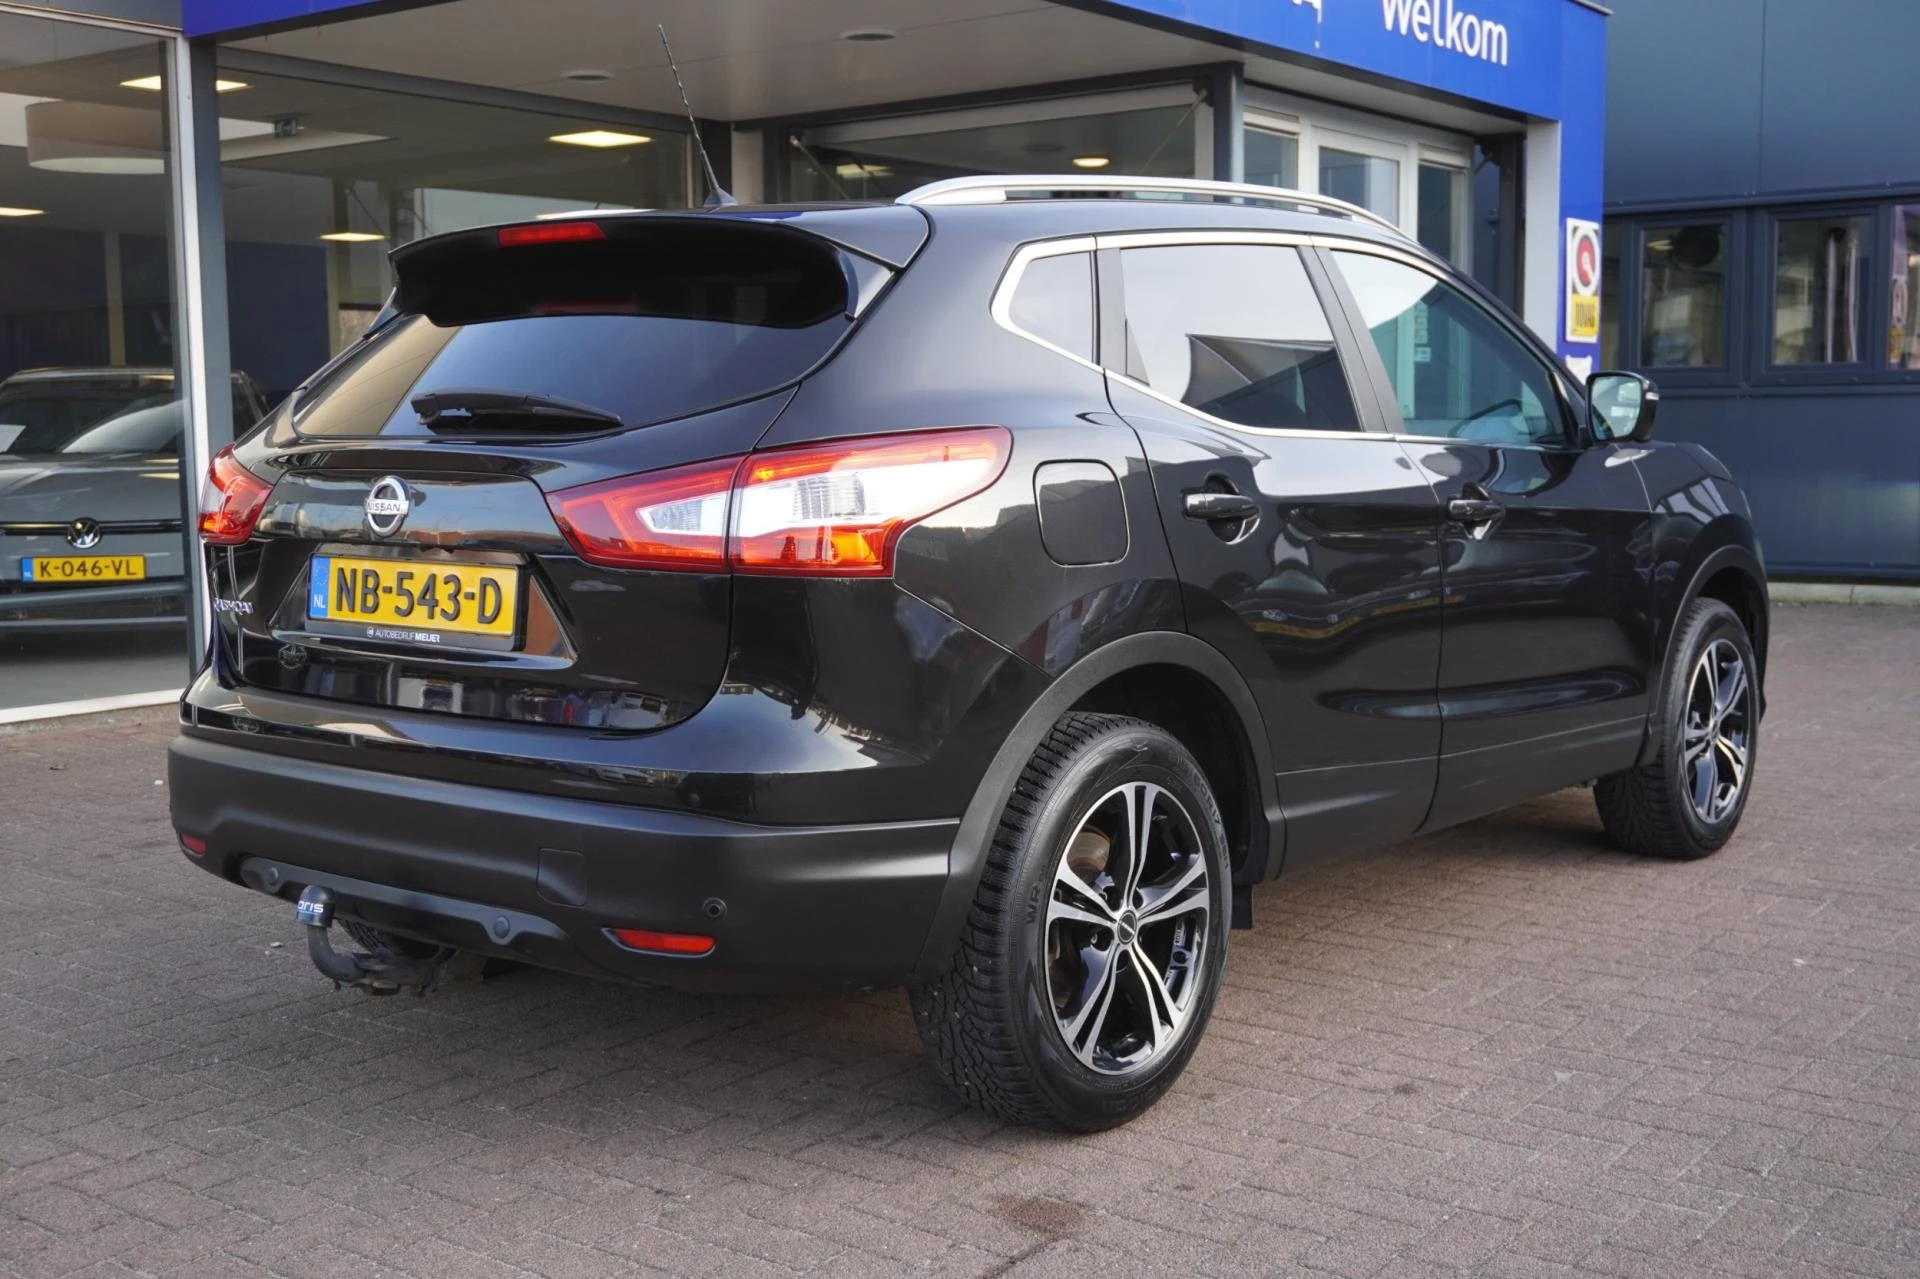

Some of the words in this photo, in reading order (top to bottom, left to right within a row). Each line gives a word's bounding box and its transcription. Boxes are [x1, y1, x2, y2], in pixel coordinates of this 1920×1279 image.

[1381, 0, 1508, 66] Welkom
[367, 502, 401, 512] NISSAN
[40, 560, 136, 578] K-046-VL
[313, 595, 326, 609] NL
[335, 567, 501, 625] NB-543-D
